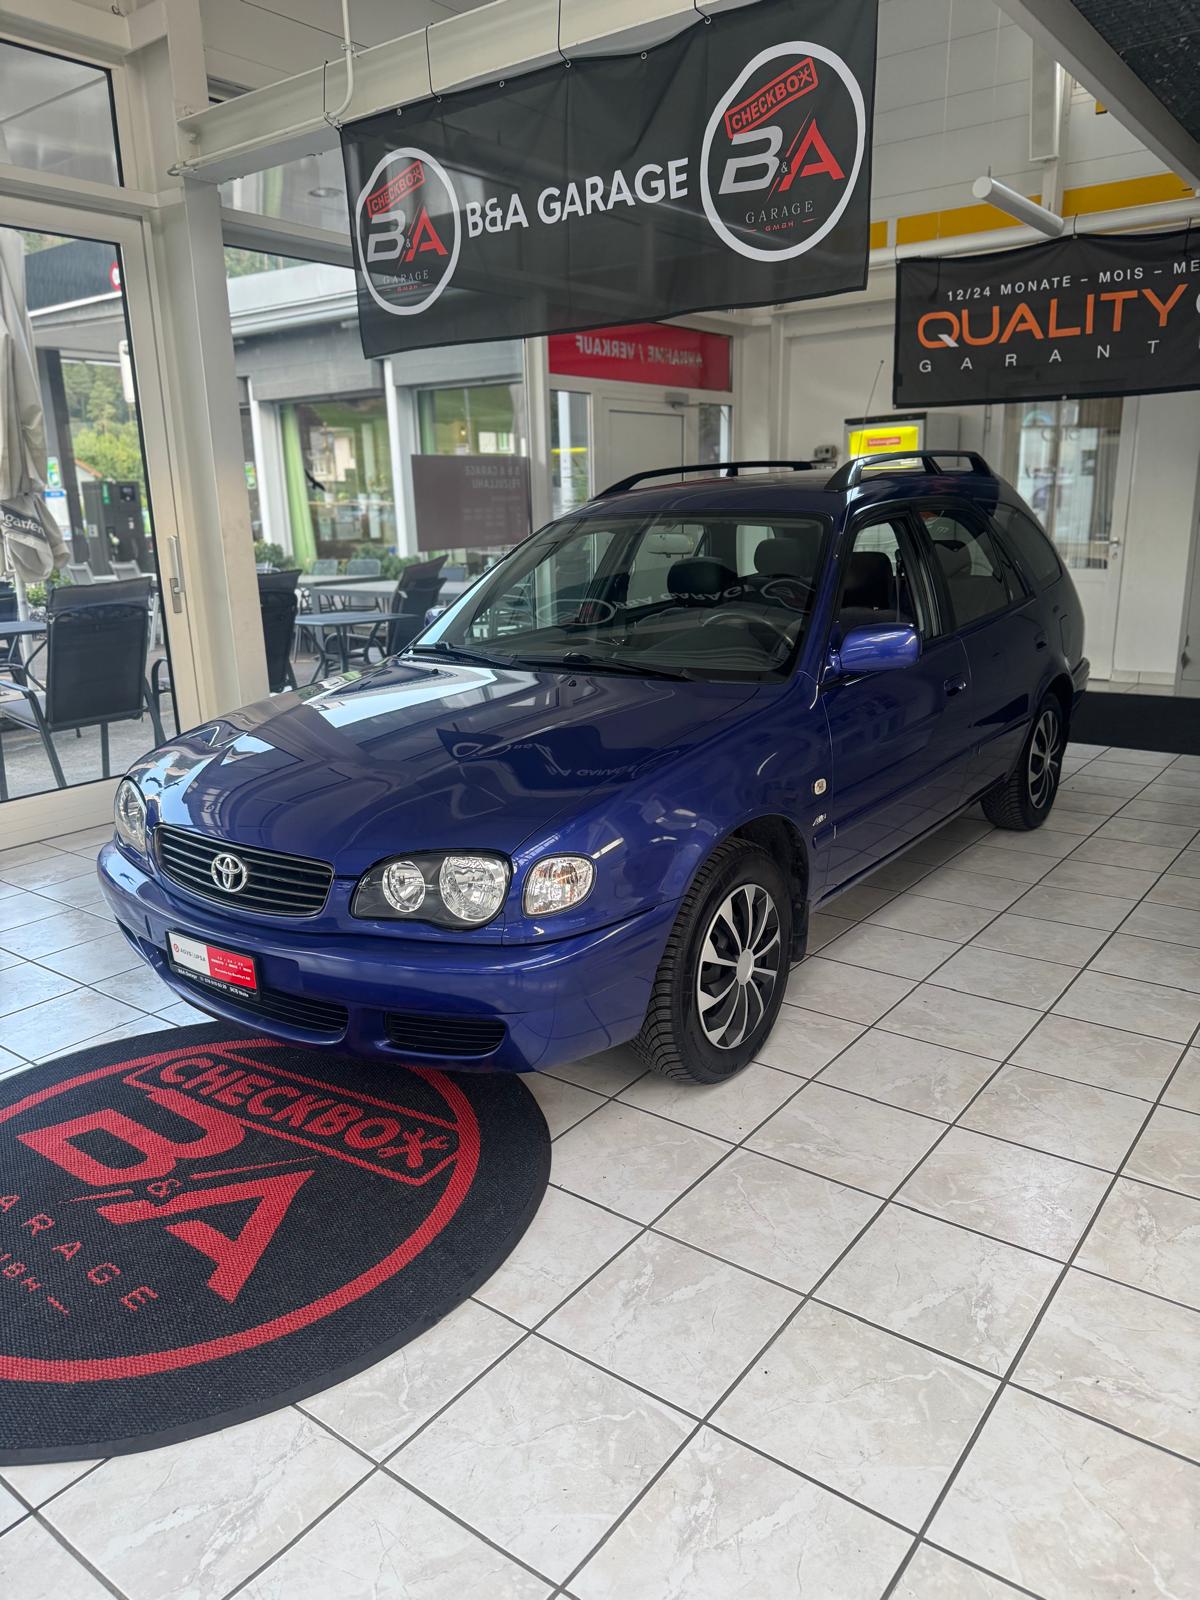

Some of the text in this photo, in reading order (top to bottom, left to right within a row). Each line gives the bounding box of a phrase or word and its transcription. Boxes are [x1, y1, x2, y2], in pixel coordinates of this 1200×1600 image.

[731, 64, 813, 130] CHECKBOX
[371, 167, 422, 211] CHECKBOX
[466, 157, 689, 238] B&A GARAGE
[745, 200, 814, 225] GARAGE
[383, 270, 429, 285] GARAGE
[947, 286, 991, 301] 12/24
[1001, 275, 1072, 295] MONATE
[1098, 267, 1144, 283] MOIS
[917, 283, 1189, 349] QUALITY
[919, 335, 1200, 373] GARANT
[0, 511, 47, 537] garten
[160, 1057, 450, 1169] CHECKBOX
